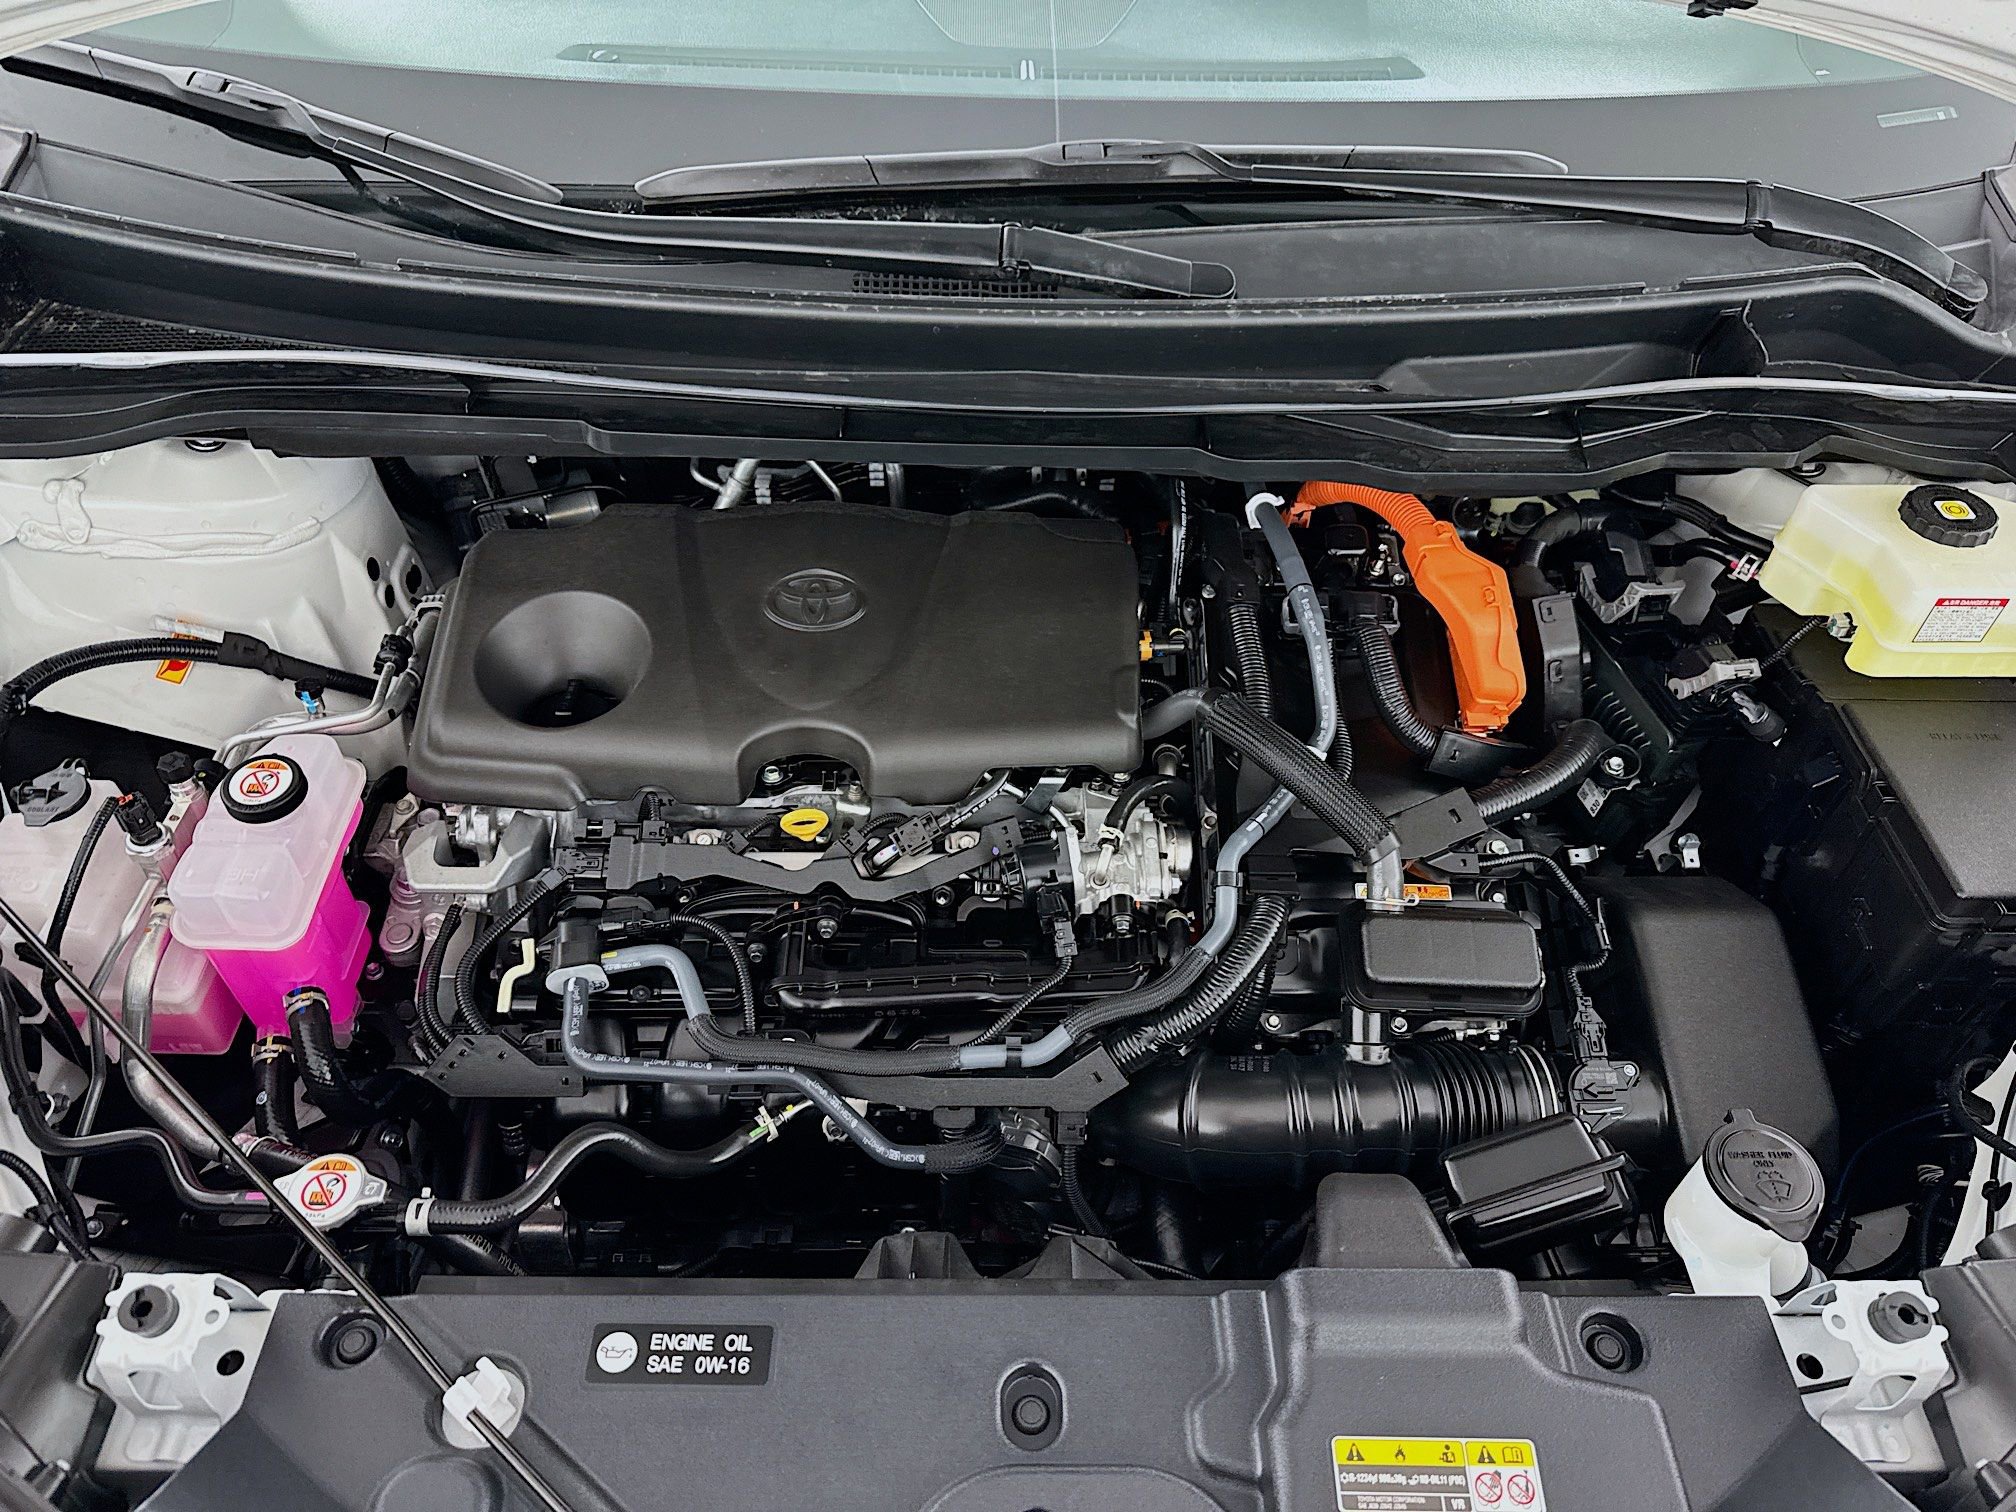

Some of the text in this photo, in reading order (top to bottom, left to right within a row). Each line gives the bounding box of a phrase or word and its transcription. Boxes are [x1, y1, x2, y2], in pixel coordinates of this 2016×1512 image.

[1727, 1151, 1793, 1159] WASHER FLUID
[1753, 1160, 1775, 1168] ONLY
[650, 1333, 753, 1352] ENGINE OIL
[646, 1355, 751, 1375] SAE 0W-16
